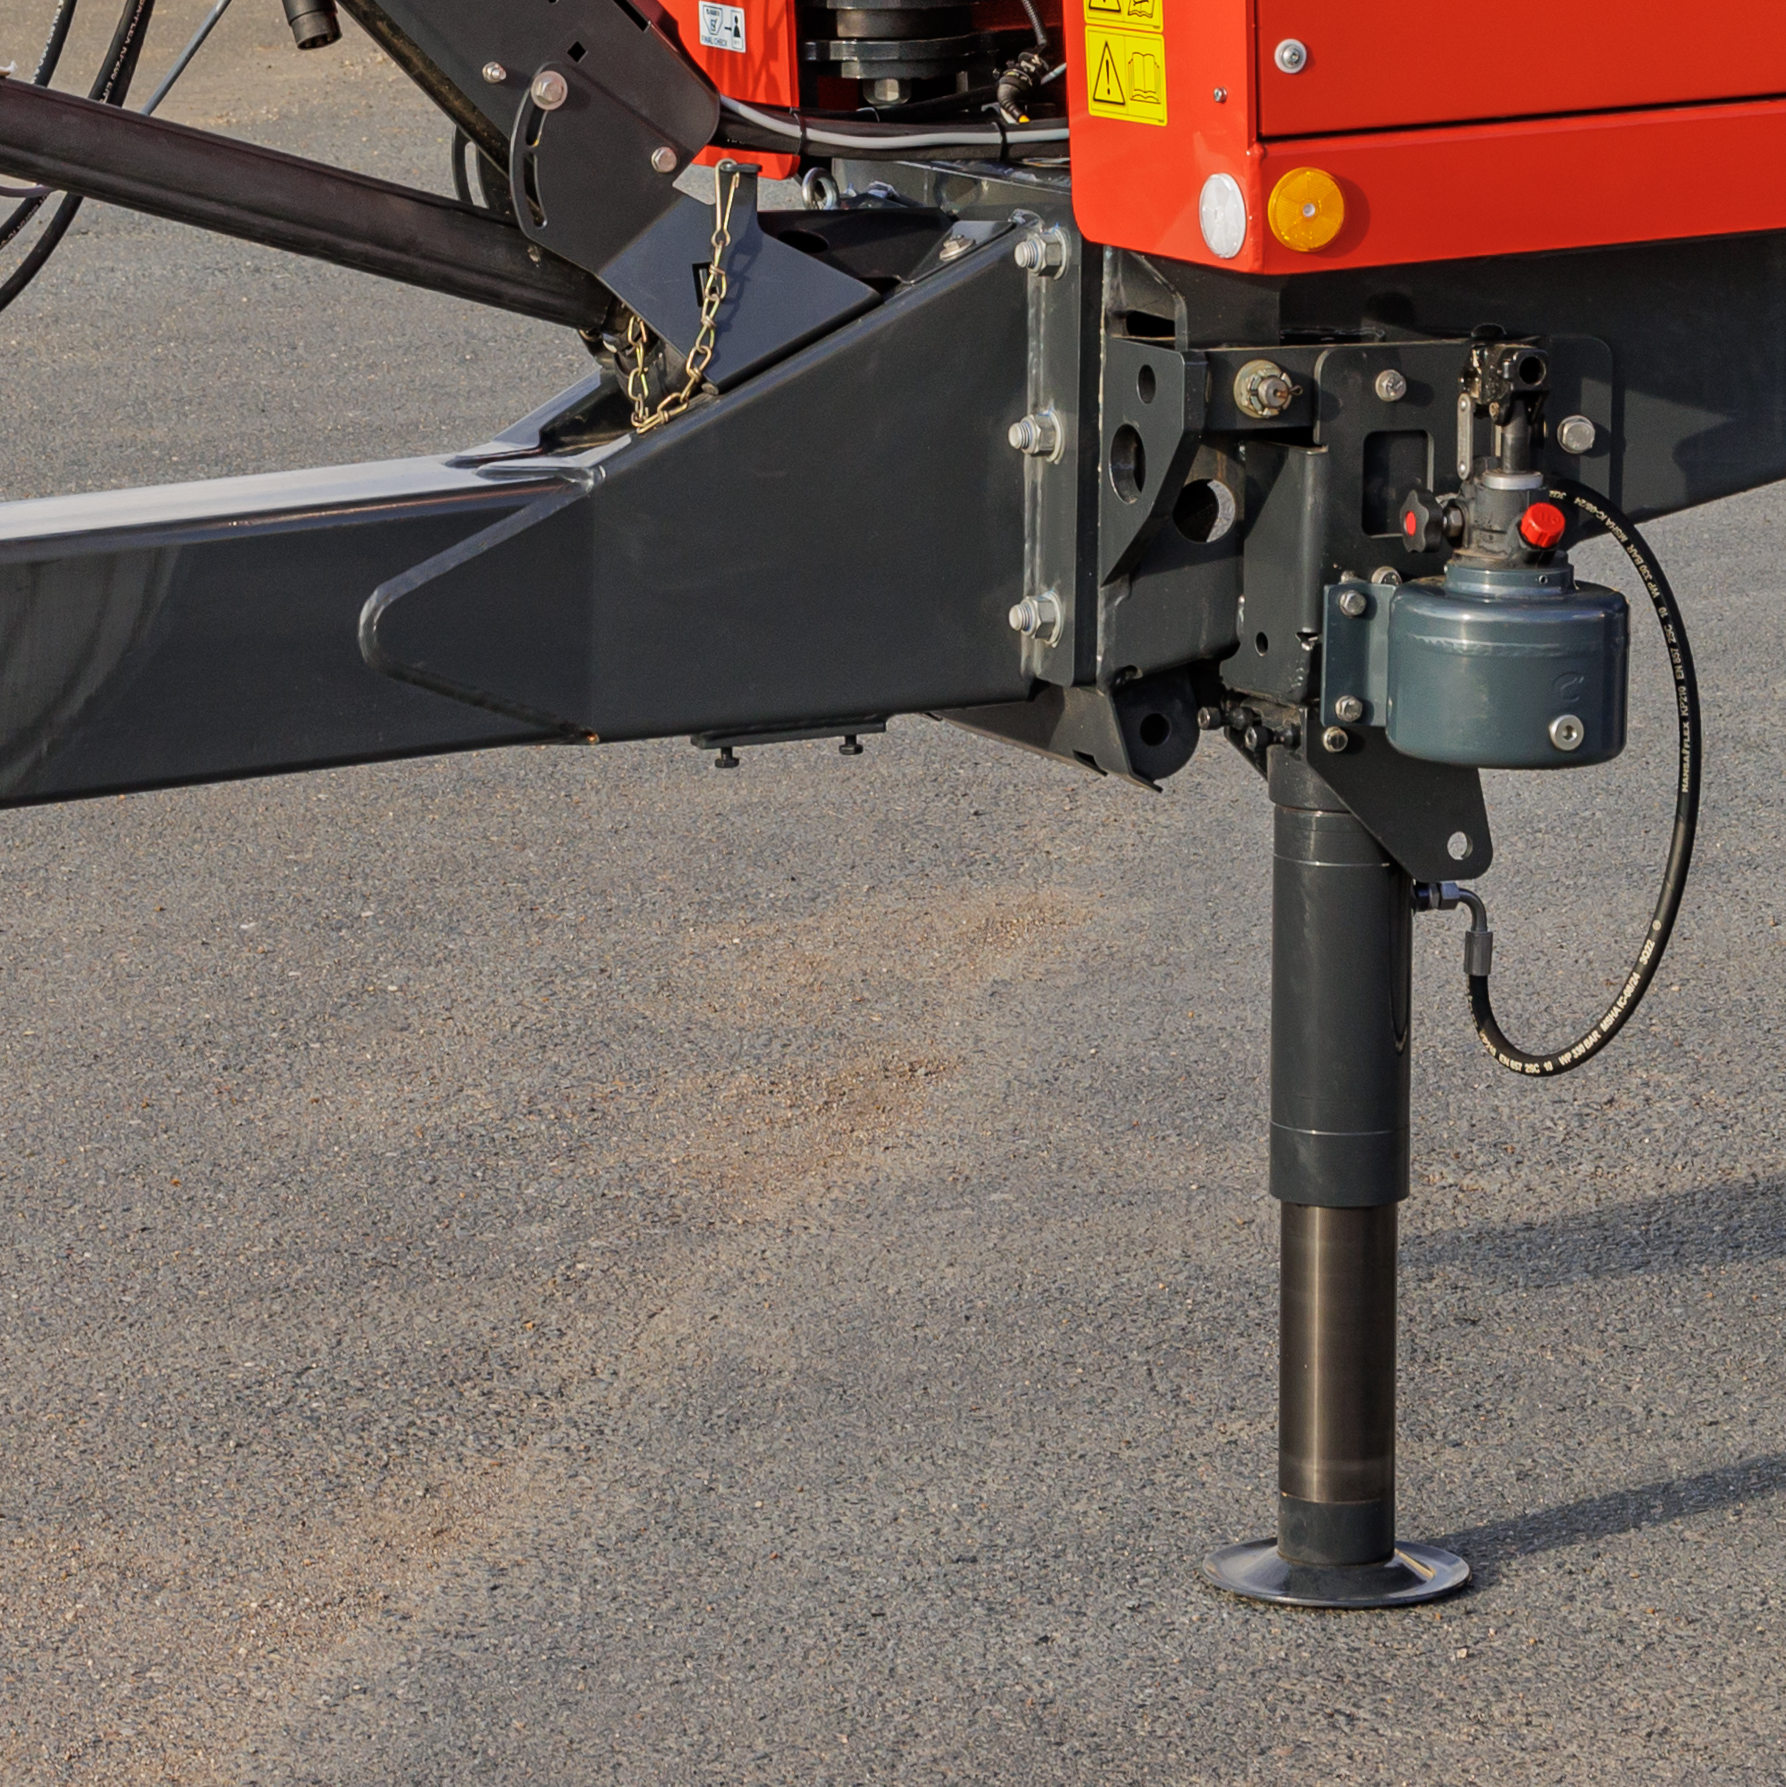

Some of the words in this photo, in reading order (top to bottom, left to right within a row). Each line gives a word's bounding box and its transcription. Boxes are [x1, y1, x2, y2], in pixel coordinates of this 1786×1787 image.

[1605, 518, 1629, 542] MSHA
[1626, 543, 1644, 565] BAR
[1638, 564, 1653, 581] 330
[1647, 581, 1660, 599] WP
[1658, 606, 1669, 618] 10
[1664, 624, 1677, 644] 2SC
[1670, 647, 1682, 664] 857
[1674, 665, 1684, 680] EN
[1678, 686, 1688, 717] KP210
